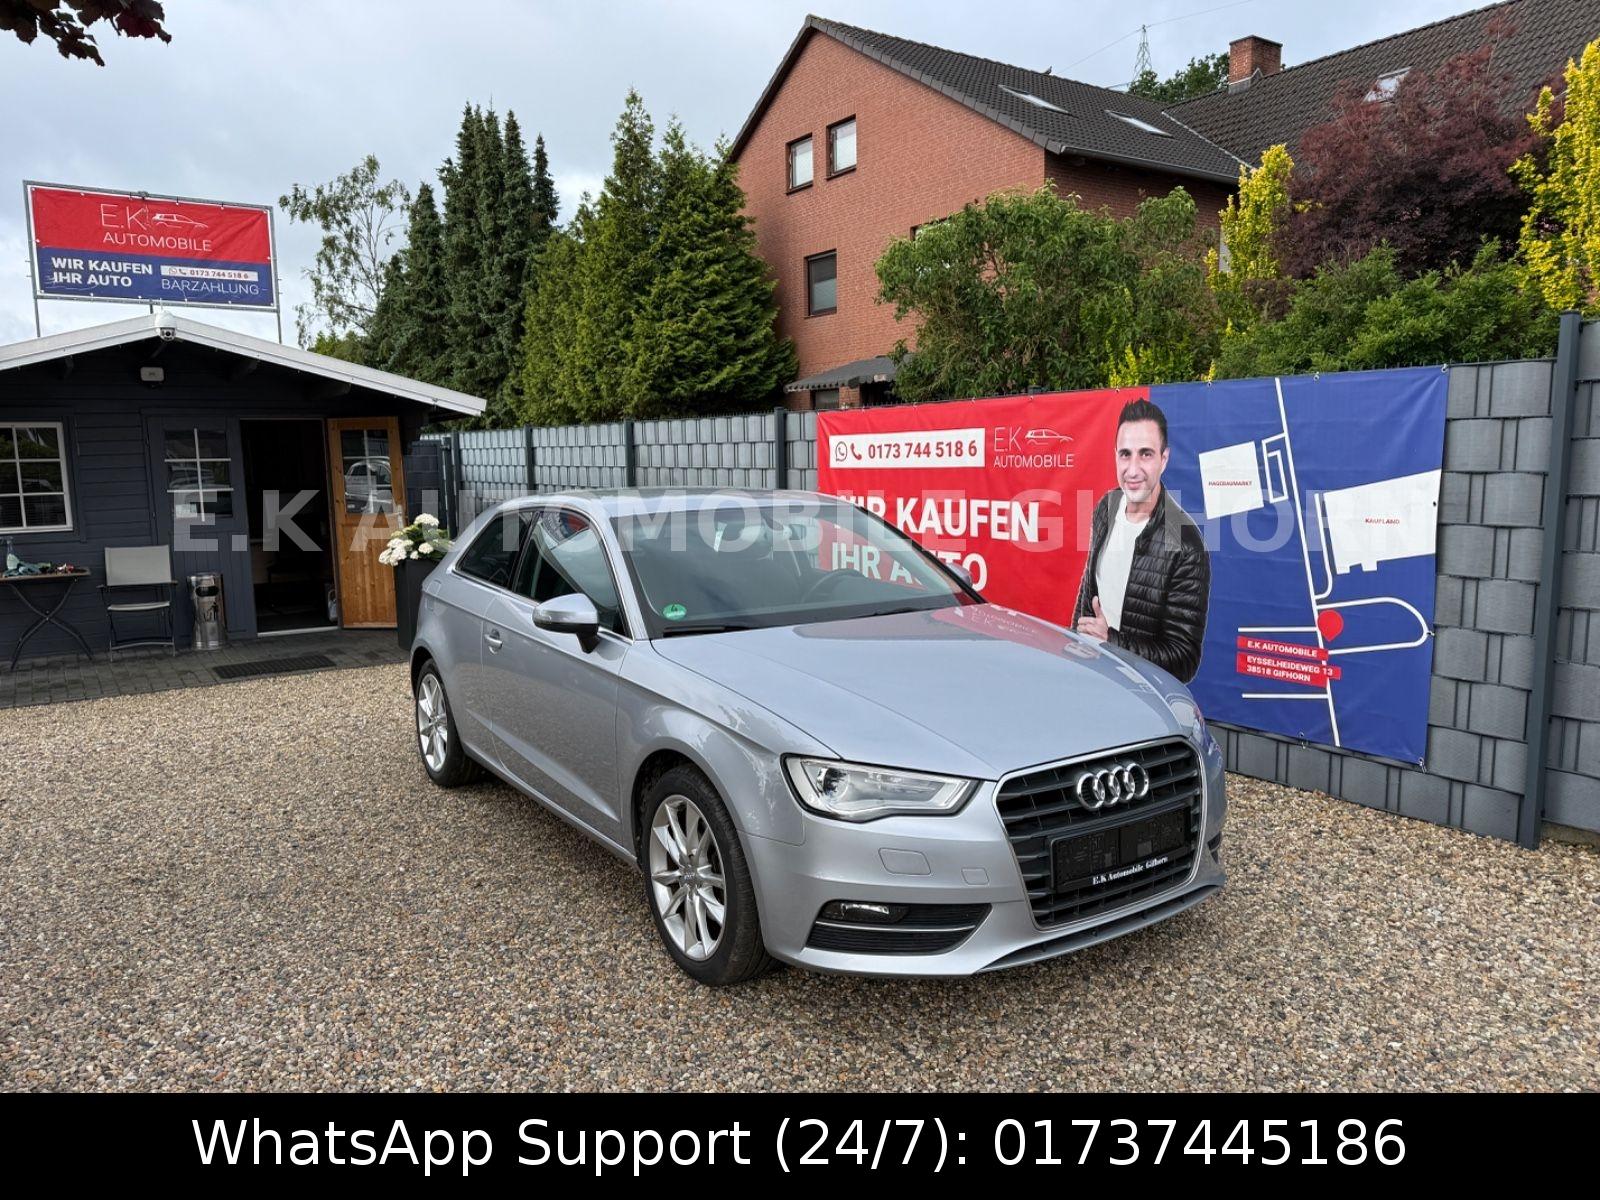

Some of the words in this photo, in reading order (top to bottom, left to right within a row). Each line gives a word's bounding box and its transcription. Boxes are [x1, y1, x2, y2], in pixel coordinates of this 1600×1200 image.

[100, 203, 147, 231] E.K
[103, 231, 212, 252] AUTOMOBILE
[51, 257, 84, 271] WIR
[88, 260, 153, 275] KAUFEN
[190, 269, 210, 277] 0173
[53, 271, 83, 285] IHR
[87, 274, 132, 287] AUTO
[161, 279, 260, 295] BARZAHLUNG
[994, 426, 1022, 452] E.K
[868, 443, 901, 460] 0173
[905, 442, 931, 459] 744
[935, 440, 964, 457] 518
[968, 440, 978, 456] 6
[993, 454, 1075, 468] AUTOMOBILE
[896, 497, 1040, 543] KAUFEN
[832, 542, 881, 579] IHR
[890, 549, 988, 592] ATO
[1247, 640, 1260, 650] E.K
[1262, 643, 1318, 658] AUTOMOBILE
[1246, 655, 1320, 674] EYSSELHEIDEWEG
[1323, 667, 1333, 676] 13
[1246, 664, 1271, 676] 38518
[1273, 669, 1310, 682] GIFHORN
